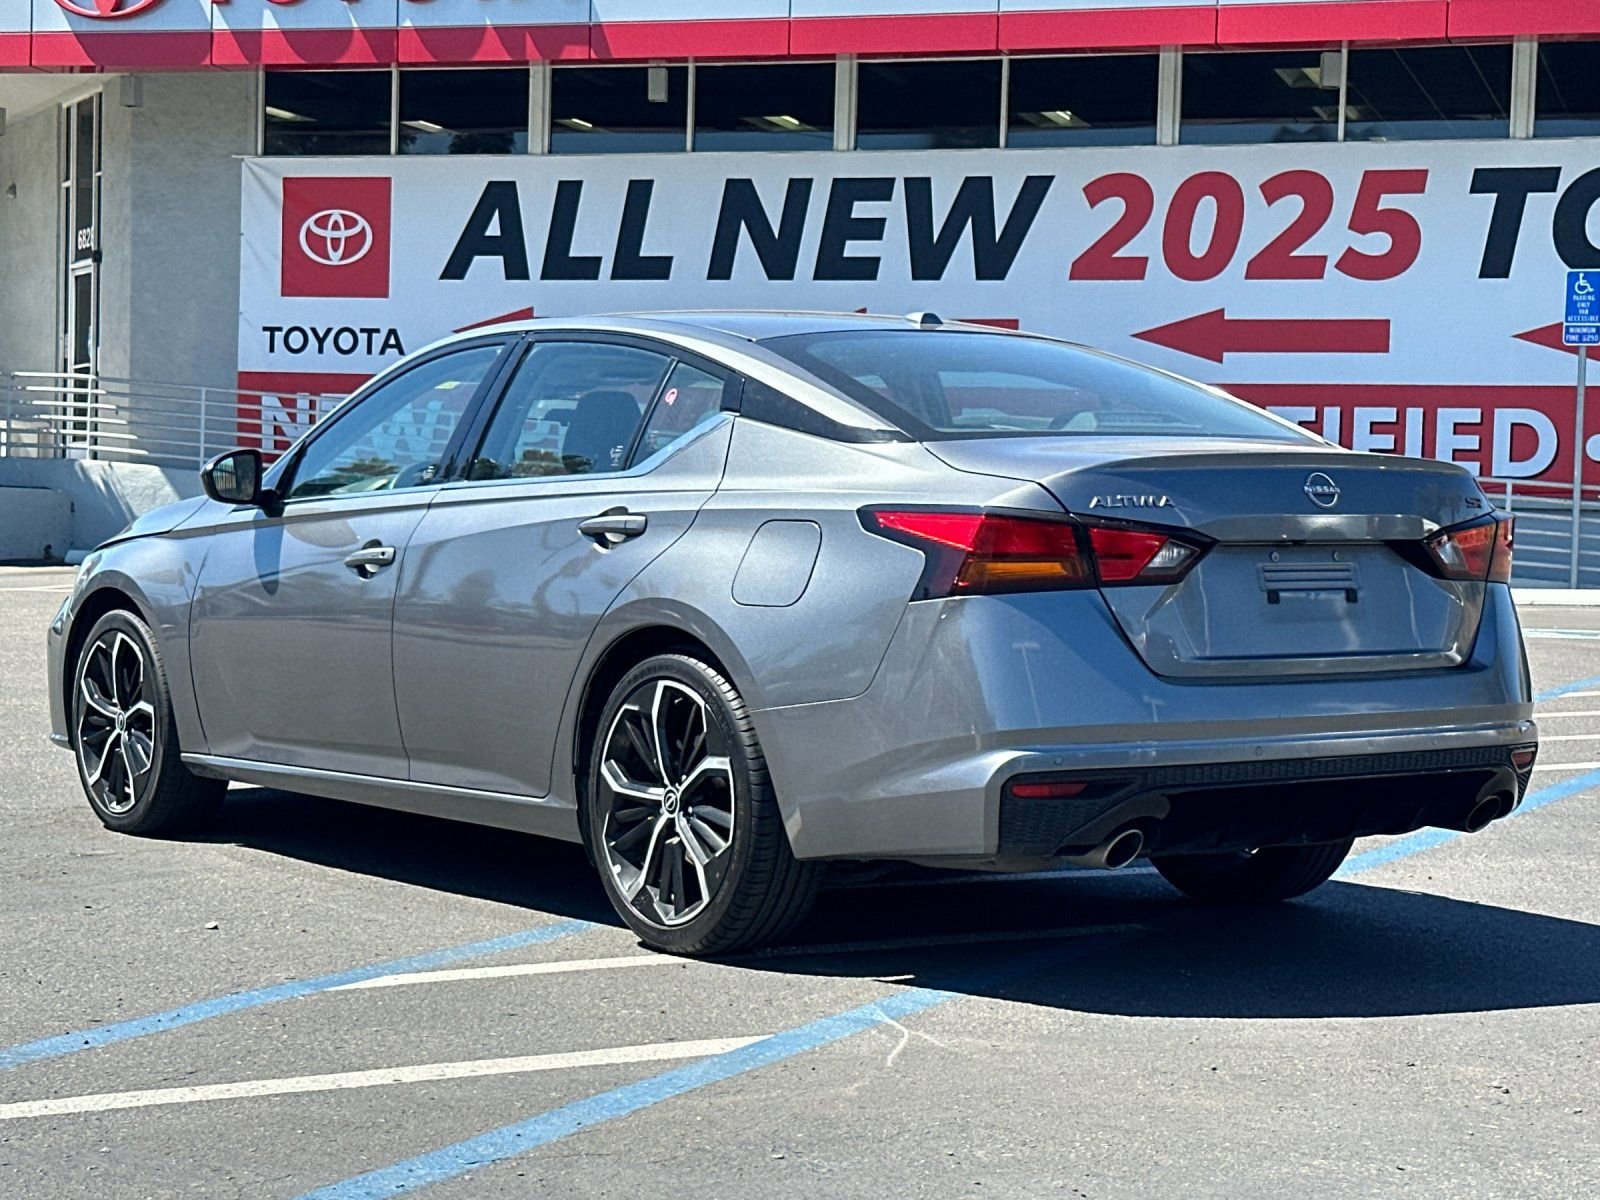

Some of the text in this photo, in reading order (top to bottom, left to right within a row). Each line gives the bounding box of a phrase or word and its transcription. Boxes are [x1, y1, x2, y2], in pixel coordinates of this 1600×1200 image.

[439, 179, 674, 280] ALL
[706, 175, 1055, 281] NEW
[1069, 169, 1429, 281] 2025
[262, 326, 406, 355] TOYOTA
[1303, 485, 1341, 494] NISSAN
[1089, 495, 1176, 508] ALTIMA
